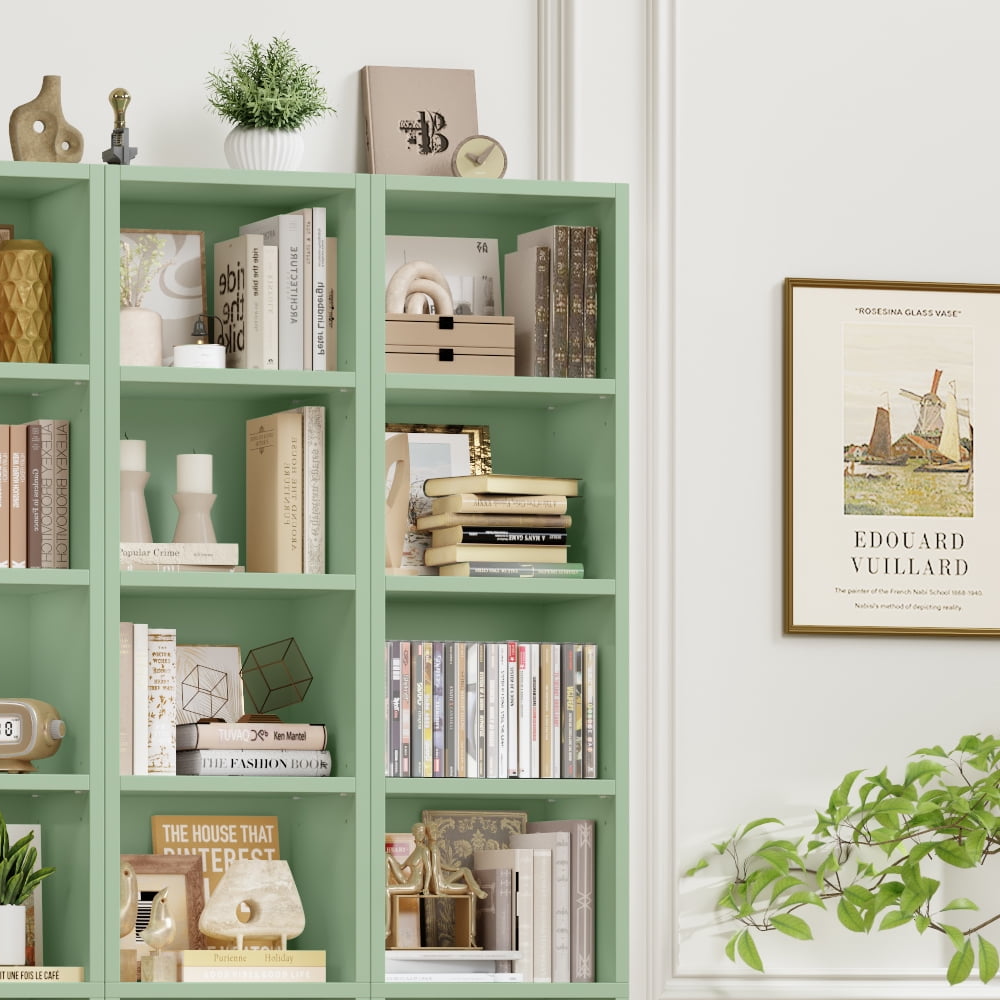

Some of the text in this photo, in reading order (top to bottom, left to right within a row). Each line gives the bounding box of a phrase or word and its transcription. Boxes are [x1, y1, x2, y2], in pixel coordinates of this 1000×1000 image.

[905, 308, 934, 317] GLASS
[854, 530, 965, 550] EDOUARD
[153, 548, 180, 557] Crime
[851, 556, 969, 576] VUILLARD
[913, 604, 942, 612] depicting
[273, 731, 307, 741] Ken Mantel
[202, 758, 229, 769] THE
[230, 758, 288, 770] FASHION
[162, 824, 274, 843] THE HOUSE THAT
[264, 953, 294, 964] Holiday
[7, 971, 19, 980] UNE
[20, 971, 34, 980] FOIS
[35, 971, 42, 980] LE
[43, 969, 60, 980] CAFÉ
